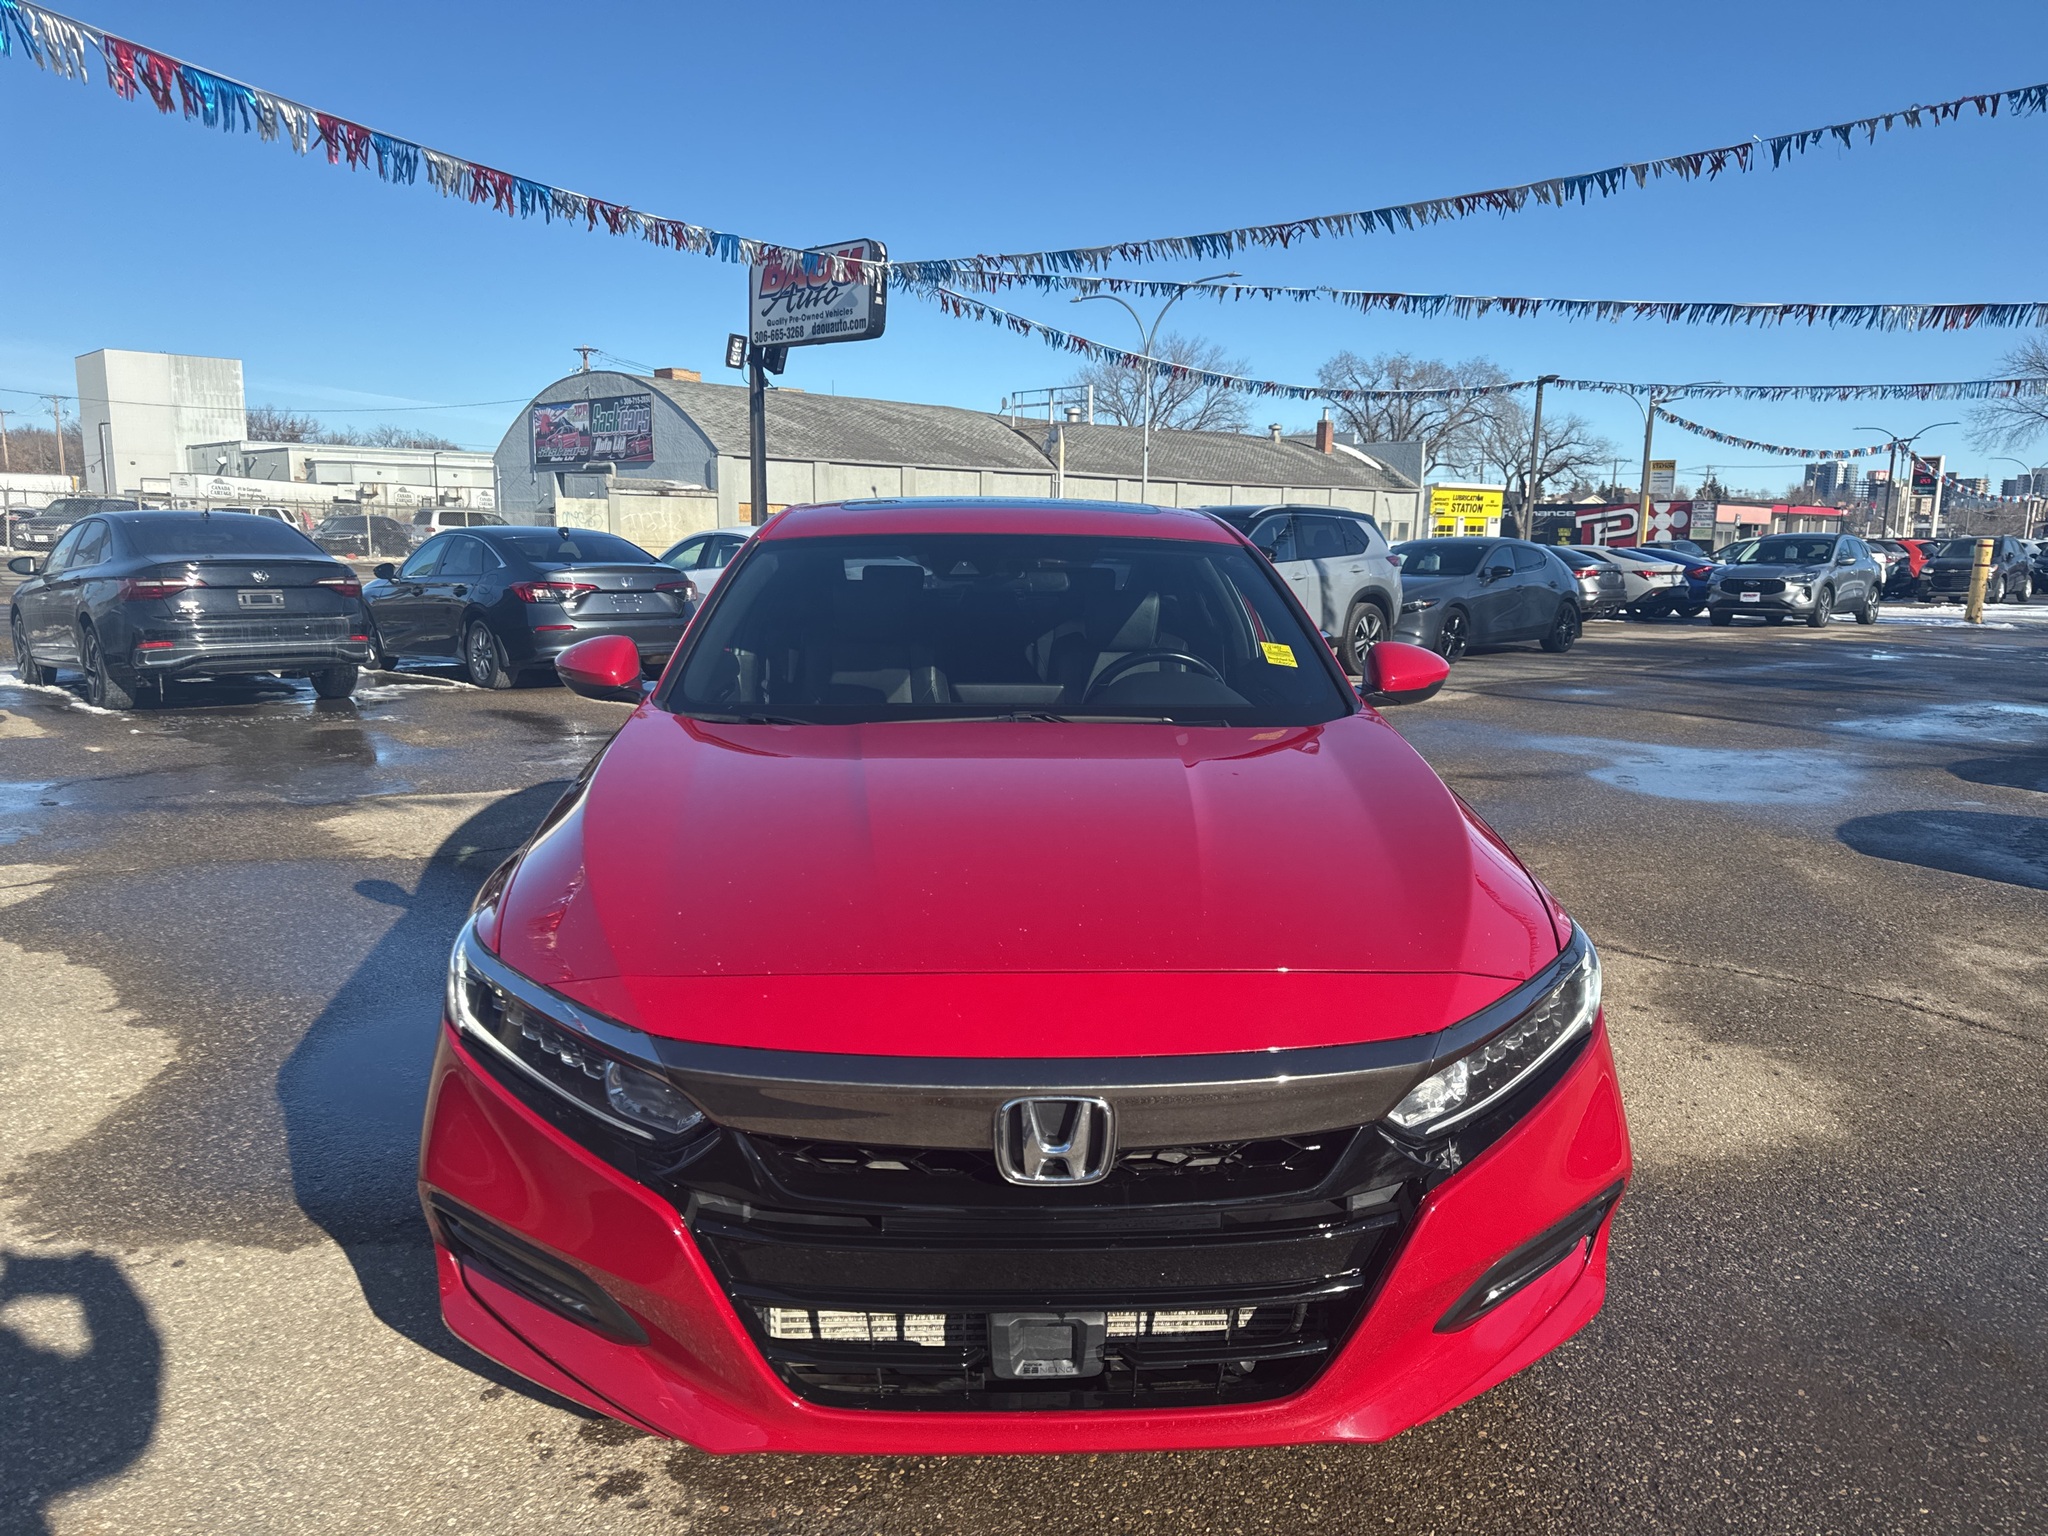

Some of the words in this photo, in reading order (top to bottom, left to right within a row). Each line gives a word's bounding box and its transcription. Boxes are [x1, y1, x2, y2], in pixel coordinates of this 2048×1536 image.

[761, 282, 843, 317] Auto
[767, 317, 788, 327] Quality
[789, 313, 824, 324] Pre-Owned
[825, 308, 853, 319] Vehicles
[754, 326, 804, 343] 306-665-3268
[811, 318, 867, 335] daouauto.com
[1451, 503, 1484, 513] STATION
